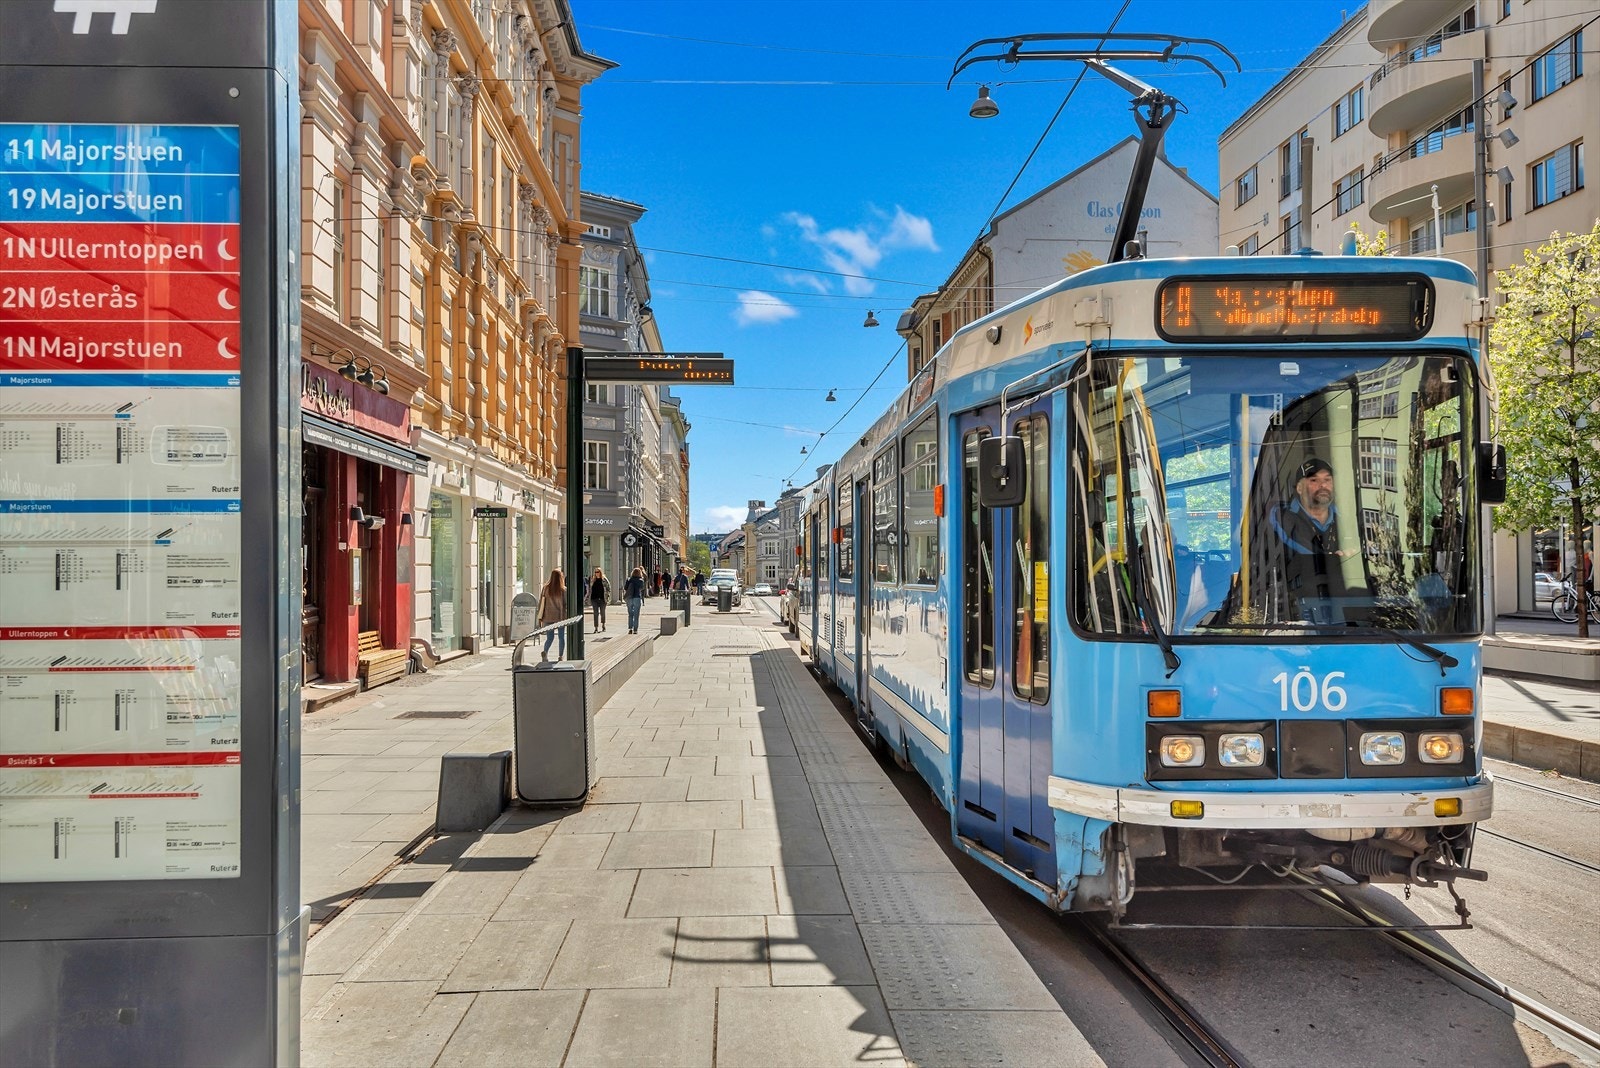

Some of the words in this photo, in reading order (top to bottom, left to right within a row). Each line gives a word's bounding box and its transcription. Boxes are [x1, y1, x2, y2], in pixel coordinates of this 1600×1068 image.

[8, 139, 35, 161] 11
[41, 139, 183, 166] Majorstuen
[8, 188, 35, 210] 19
[41, 188, 183, 215] Majorstuen
[1087, 200, 1114, 219] Clas
[1115, 201, 1161, 219] Oson
[3, 237, 36, 259] 1N
[41, 237, 203, 264] Ullerntoppen
[1, 287, 36, 309] 2N
[40, 284, 138, 309] Østerås
[3, 337, 36, 359] 1N
[41, 336, 183, 363] Majorstuen
[10, 377, 52, 385] Majorstuen
[9, 503, 52, 511] Majorstuen
[8, 629, 58, 639] Ullerntoppen
[1272, 670, 1348, 712] 106
[7, 756, 38, 765] Østerås
[38, 757, 43, 765] T
